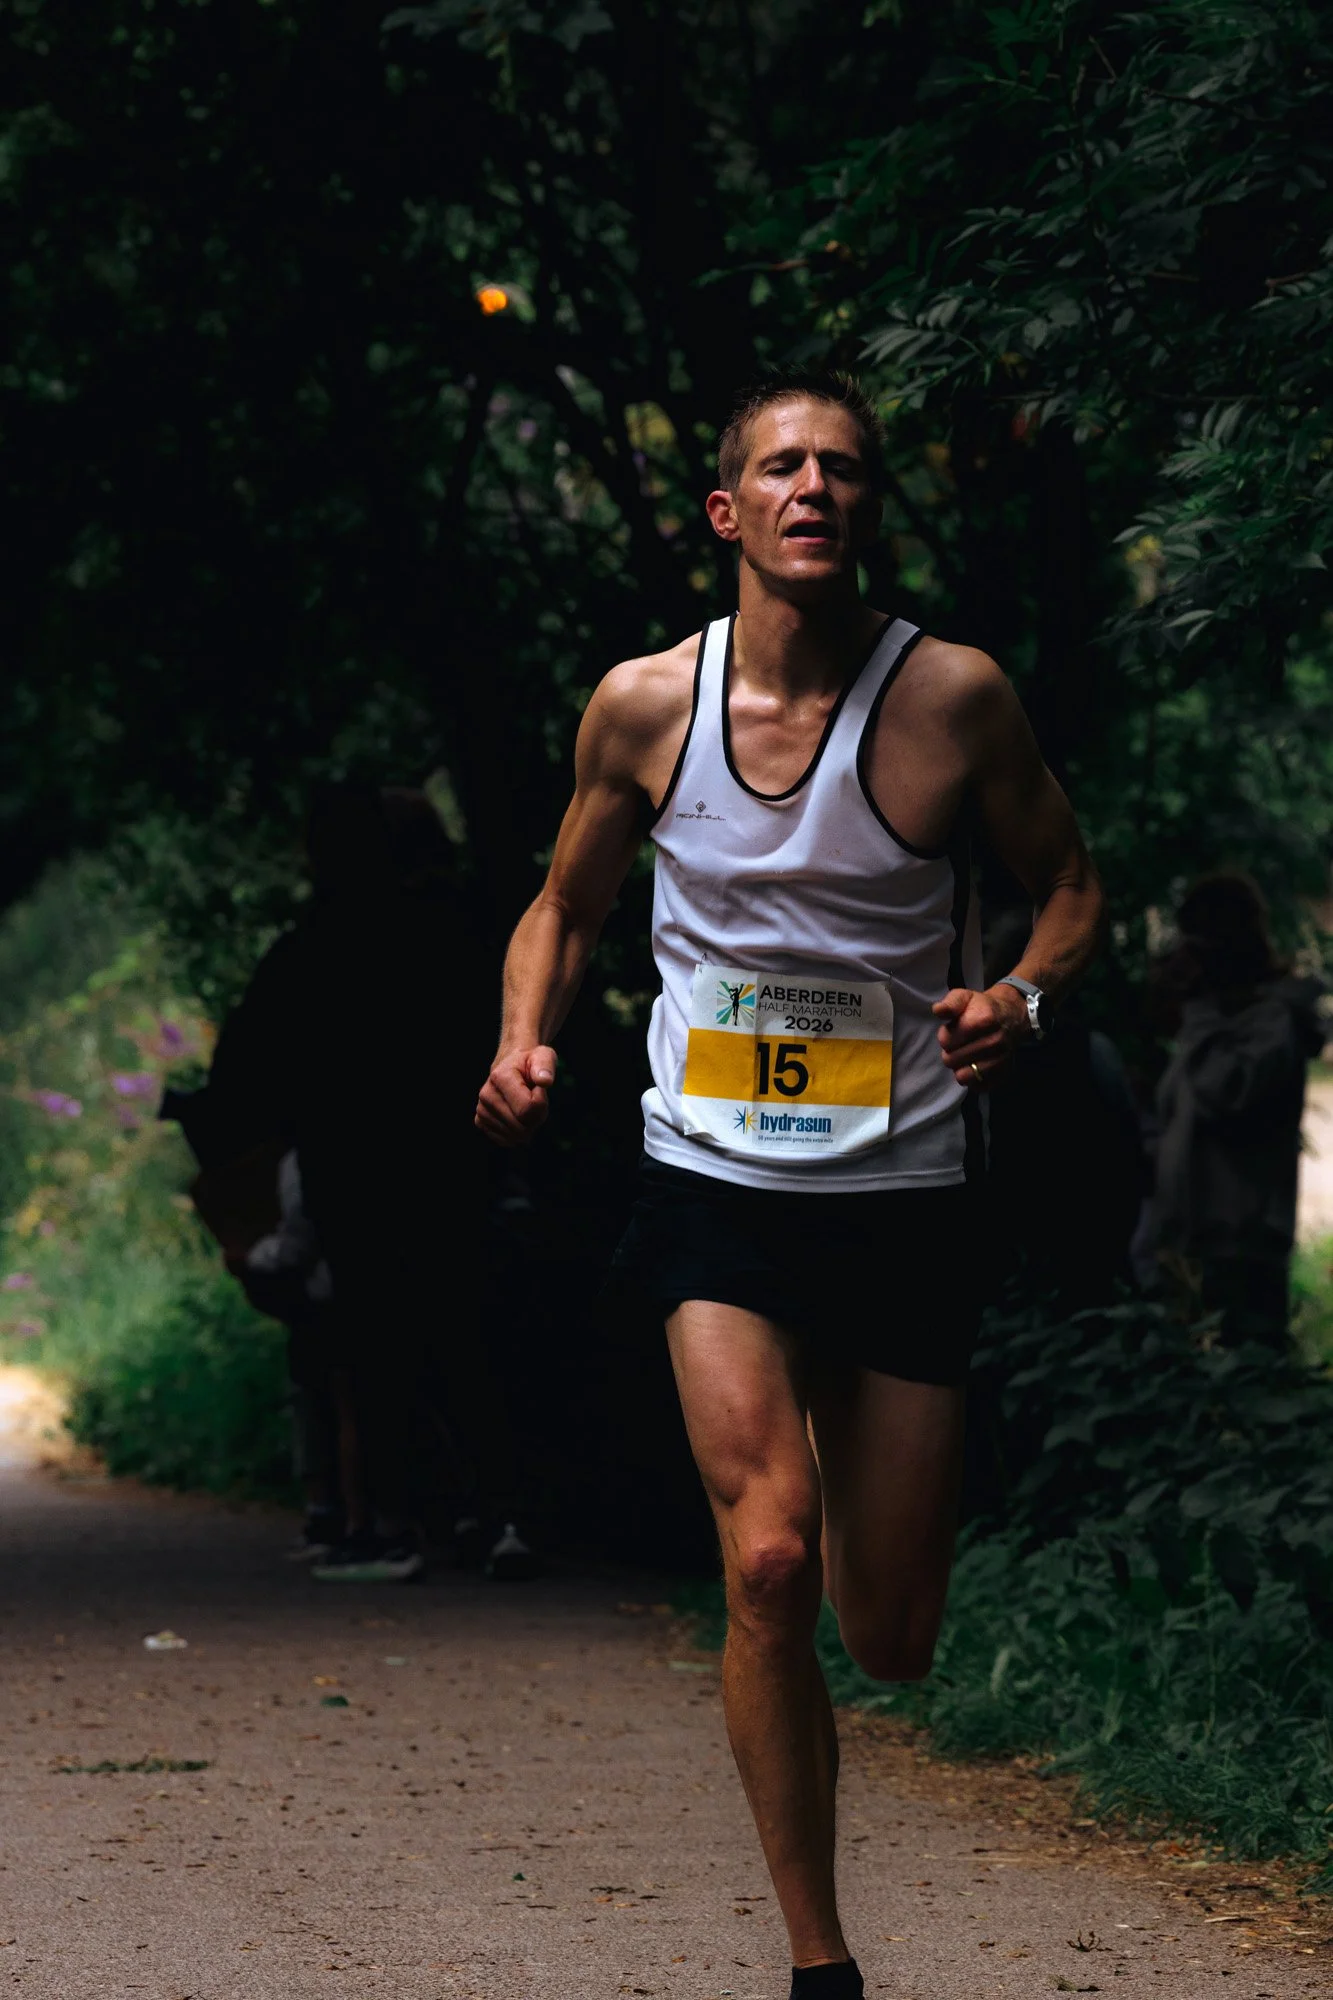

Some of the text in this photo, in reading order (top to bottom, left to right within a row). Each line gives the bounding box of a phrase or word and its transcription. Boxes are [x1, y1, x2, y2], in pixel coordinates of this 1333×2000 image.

[760, 985, 862, 1006] ABERDEEN
[758, 1002, 862, 1018] HALF MARATHON
[785, 1015, 833, 1032] 2026
[757, 1042, 809, 1096] 15
[760, 1112, 831, 1133] hydrasun
